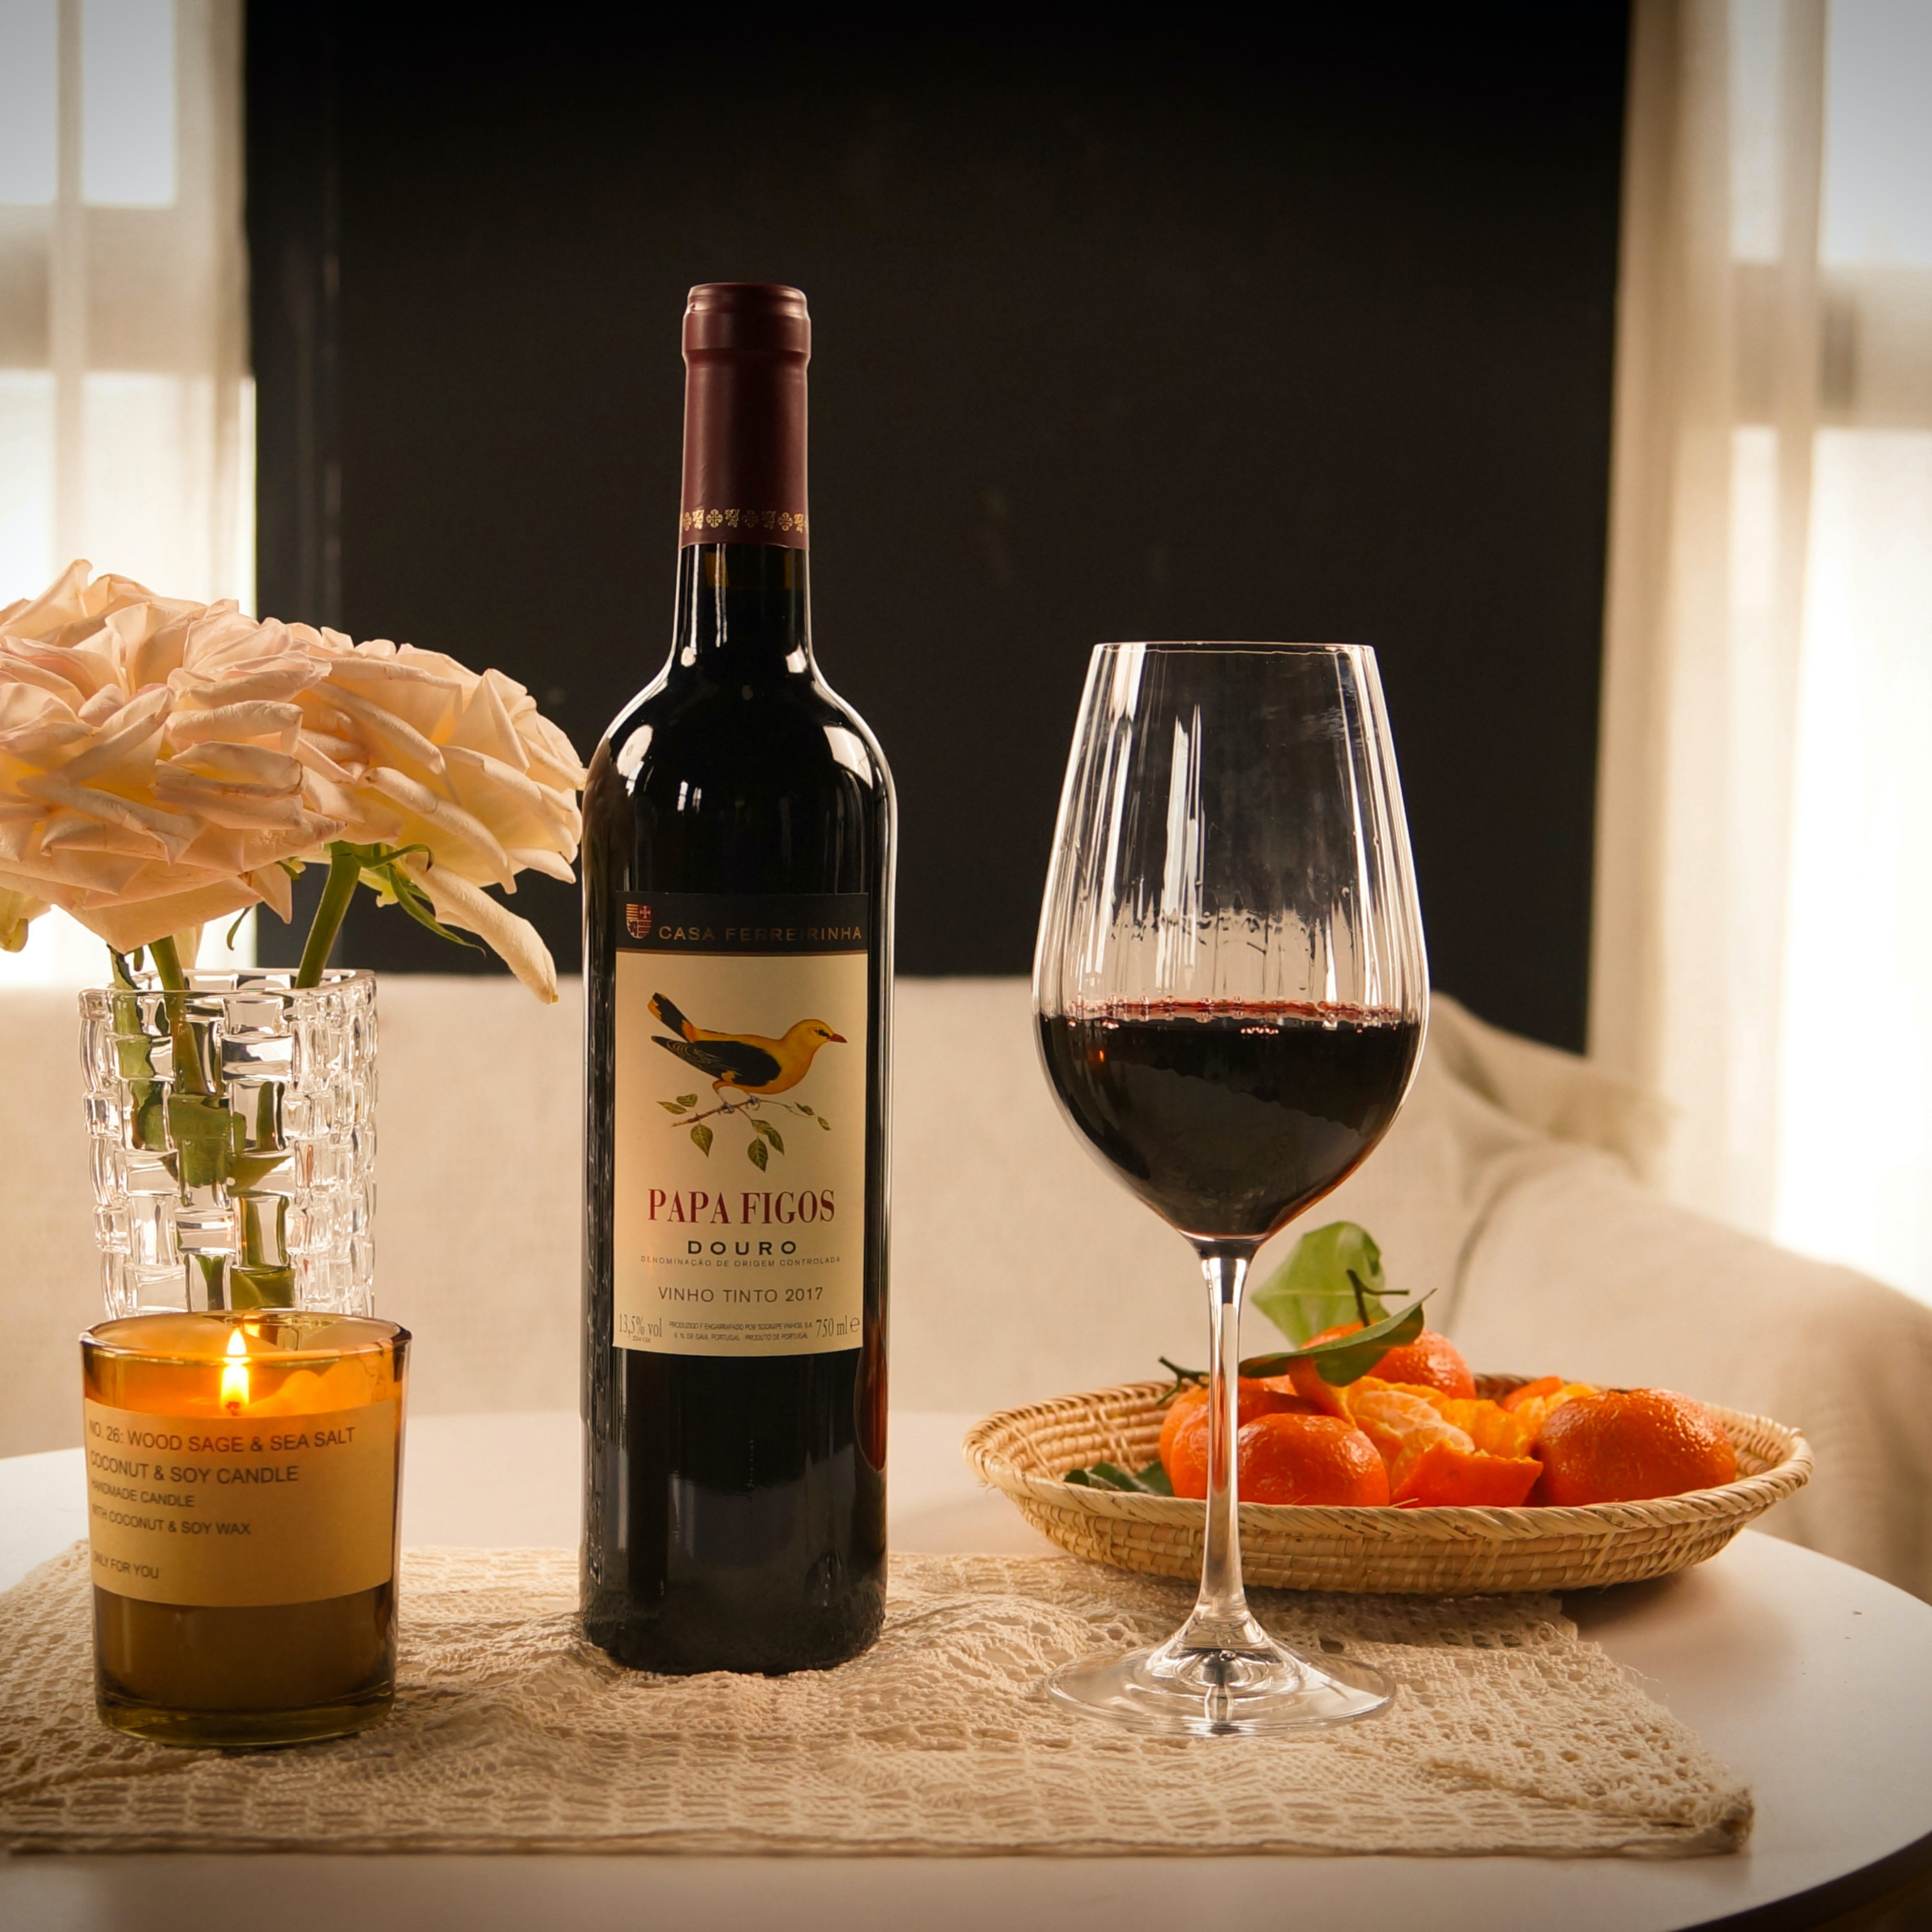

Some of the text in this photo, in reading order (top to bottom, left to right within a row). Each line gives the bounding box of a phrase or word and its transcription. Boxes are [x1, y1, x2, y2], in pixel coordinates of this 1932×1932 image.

[659, 926, 715, 941] CASA
[648, 1189, 835, 1224] PAPA FIGOS
[687, 1240, 797, 1255] DOURO
[641, 1255, 712, 1267] DENOMINAÇÃO
[780, 1256, 841, 1267] CONTROLADA
[658, 1286, 824, 1303] VINHO TINTO 2017
[619, 1313, 663, 1337] 13,5% vol
[816, 1318, 834, 1339] 750
[836, 1315, 848, 1336] ml
[89, 1420, 356, 1453] NO. 26: WOOD SAGE & SEA SALT
[90, 1450, 300, 1484] COCONUT & SOY CANDLE
[140, 1490, 195, 1507] CANDLE
[108, 1510, 164, 1532] COCONUT
[167, 1521, 177, 1533] &
[181, 1521, 210, 1534] SOY
[215, 1522, 252, 1535] WAX
[111, 1558, 131, 1575] FOR
[133, 1563, 160, 1580] YOU
